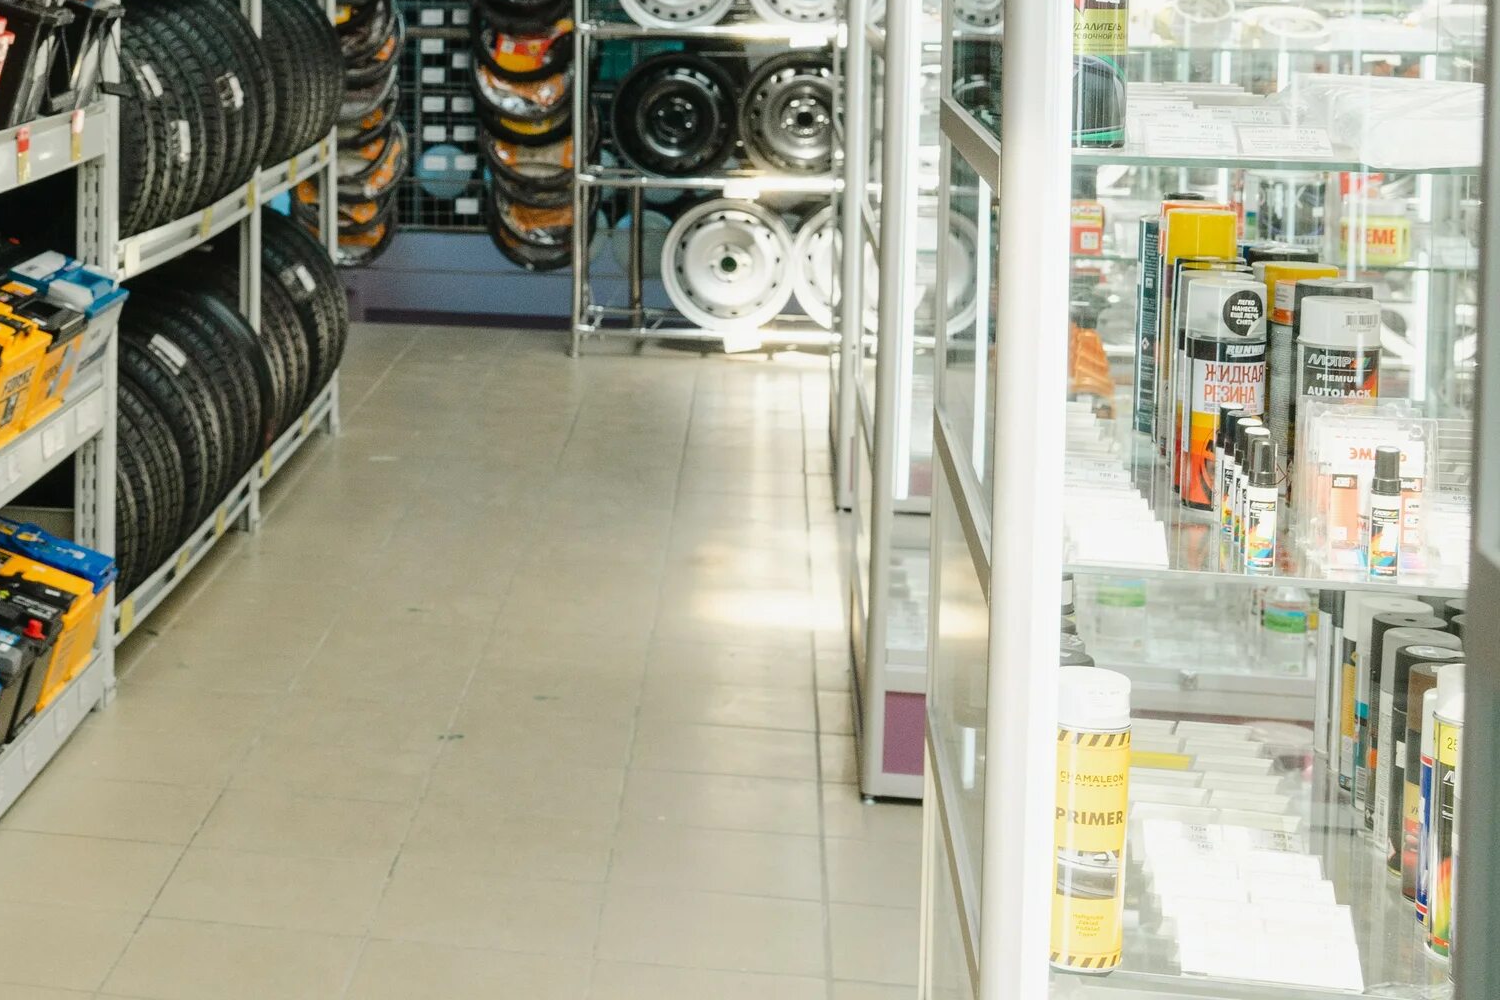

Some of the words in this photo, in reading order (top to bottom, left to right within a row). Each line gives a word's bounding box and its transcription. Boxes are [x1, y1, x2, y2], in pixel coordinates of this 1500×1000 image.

[1307, 353, 1352, 368] MOTIP
[1203, 384, 1256, 404] РЕЗИНА
[1307, 386, 1372, 399] AUTOLACK
[1056, 806, 1124, 827] PRIMER
